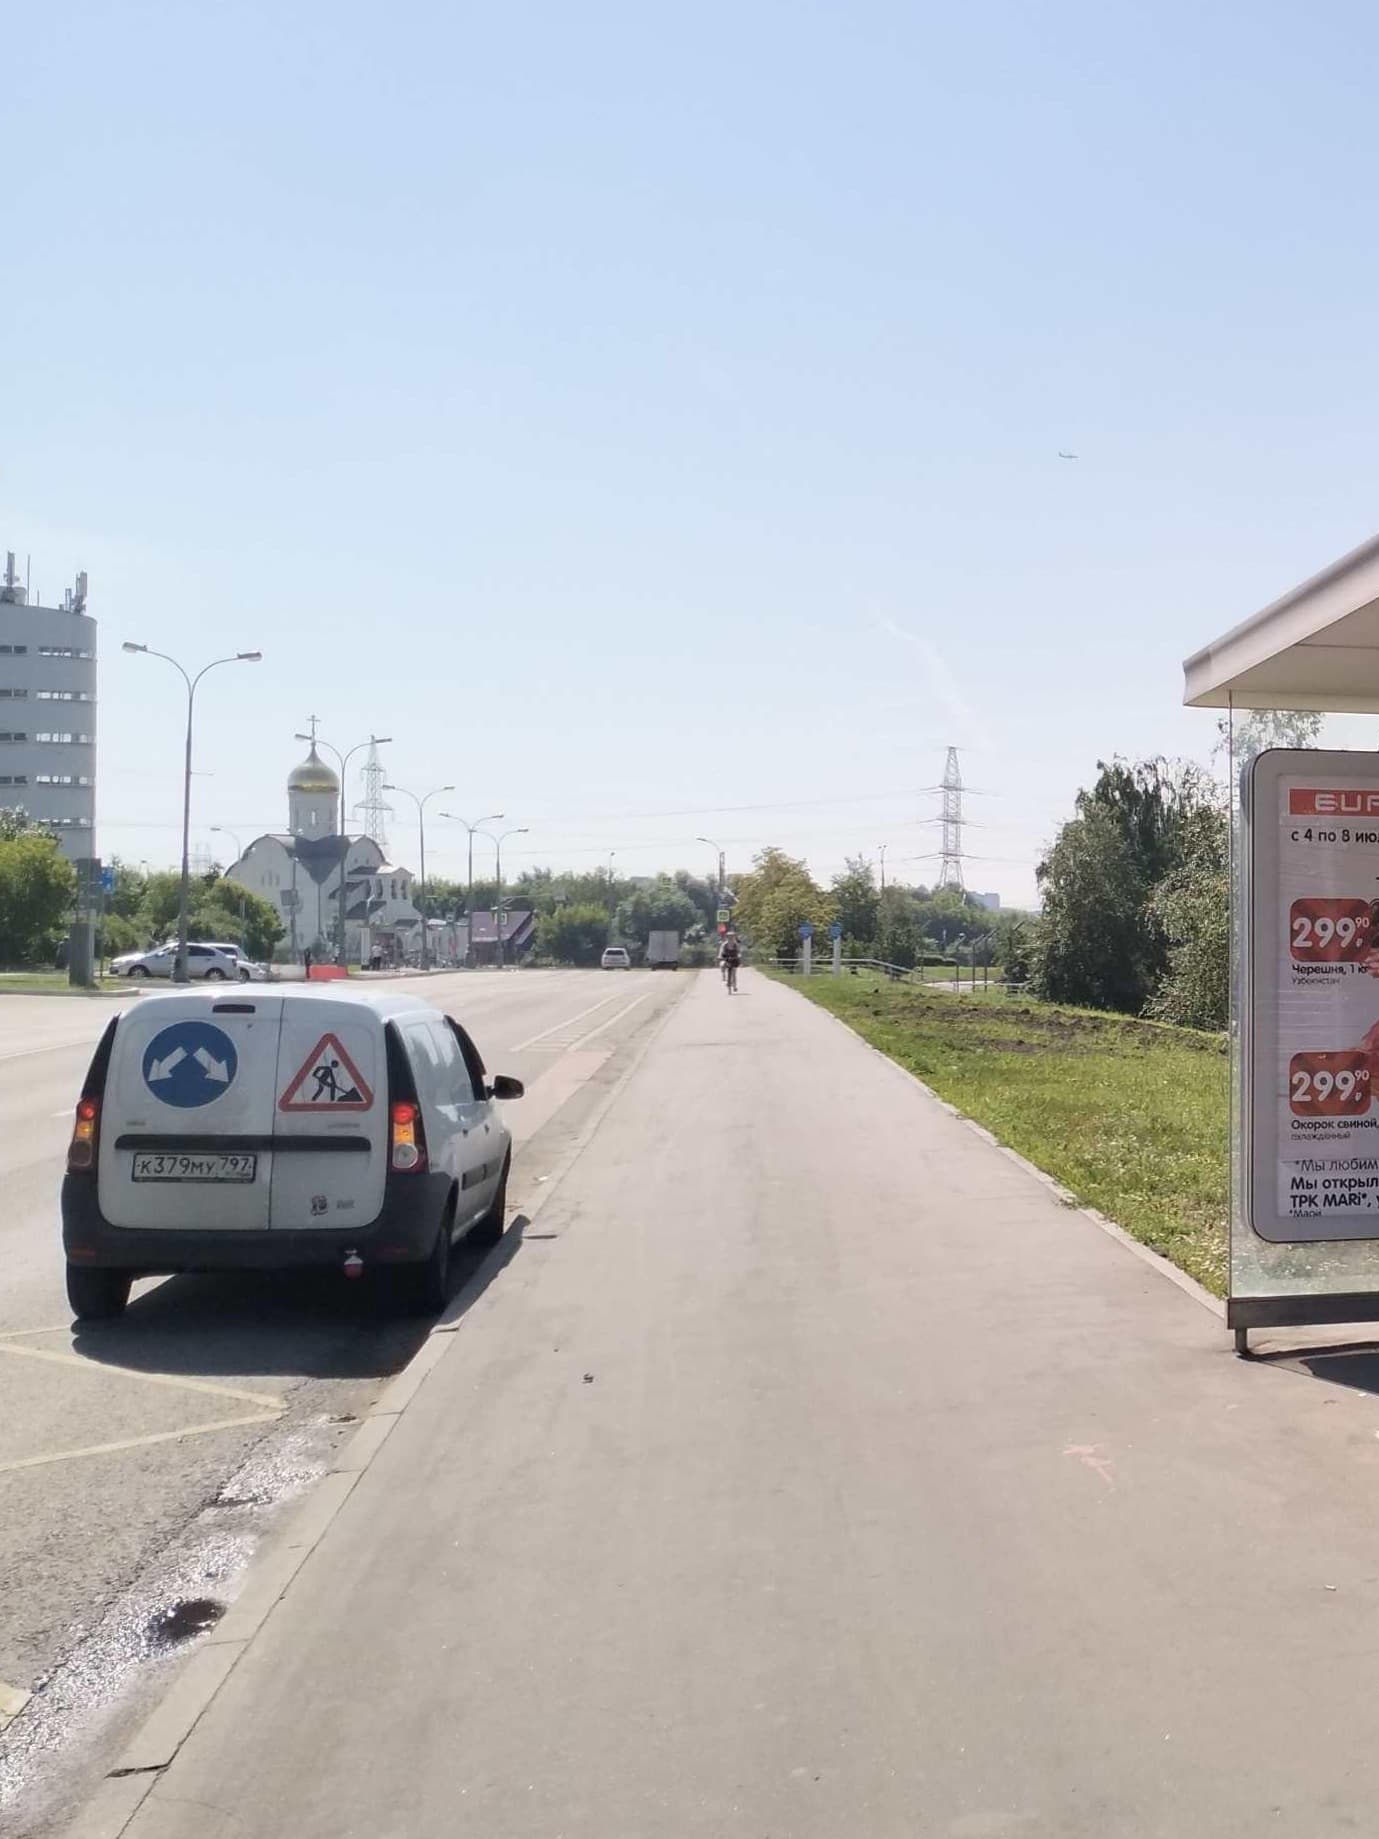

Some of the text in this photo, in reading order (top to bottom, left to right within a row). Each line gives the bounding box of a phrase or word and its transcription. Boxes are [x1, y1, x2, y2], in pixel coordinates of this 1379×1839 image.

[1291, 833, 1299, 842] с
[1304, 829, 1313, 842] 4
[1318, 832, 1337, 843] по
[1341, 829, 1350, 842] 8
[1292, 964, 1347, 977] Черешня,
[1291, 1119, 1335, 1131] Окорок
[1337, 1118, 1379, 1129] свиной,
[220, 1157, 249, 1171] 797
[1329, 1158, 1379, 1171] любим
[1290, 1176, 1318, 1190] Мы
[1290, 1194, 1319, 1208] ТРК
